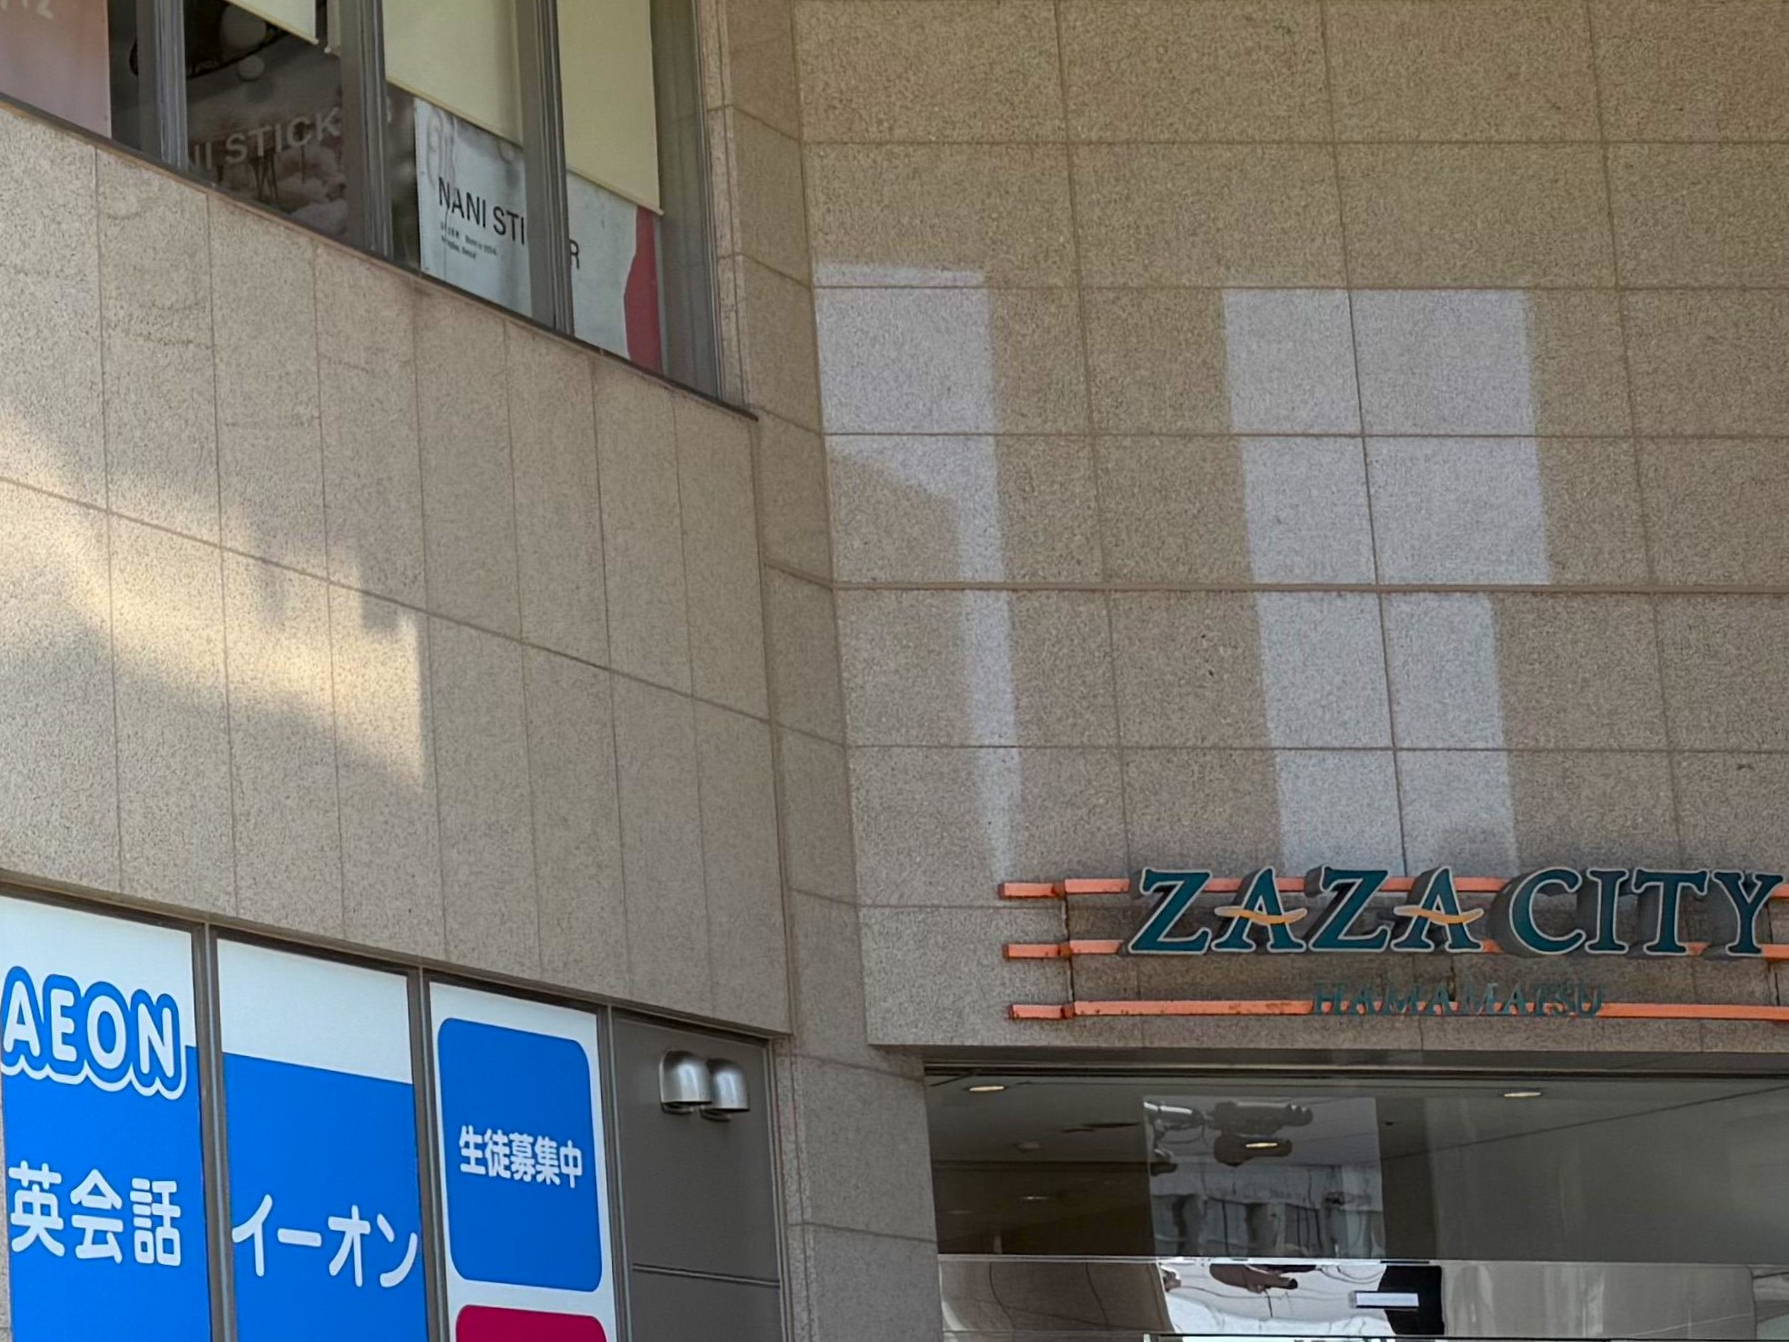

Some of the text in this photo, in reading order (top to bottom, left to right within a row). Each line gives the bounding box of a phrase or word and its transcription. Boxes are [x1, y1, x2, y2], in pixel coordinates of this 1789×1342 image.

[438, 176, 487, 228] NANI
[1128, 865, 1785, 957] ZAZA CITY
[1, 973, 180, 1089] AEON
[1311, 981, 1605, 1020] HAMAMATSU
[458, 1125, 584, 1189] 生徒募集中
[8, 1160, 419, 1289] 英会話 イーオン
